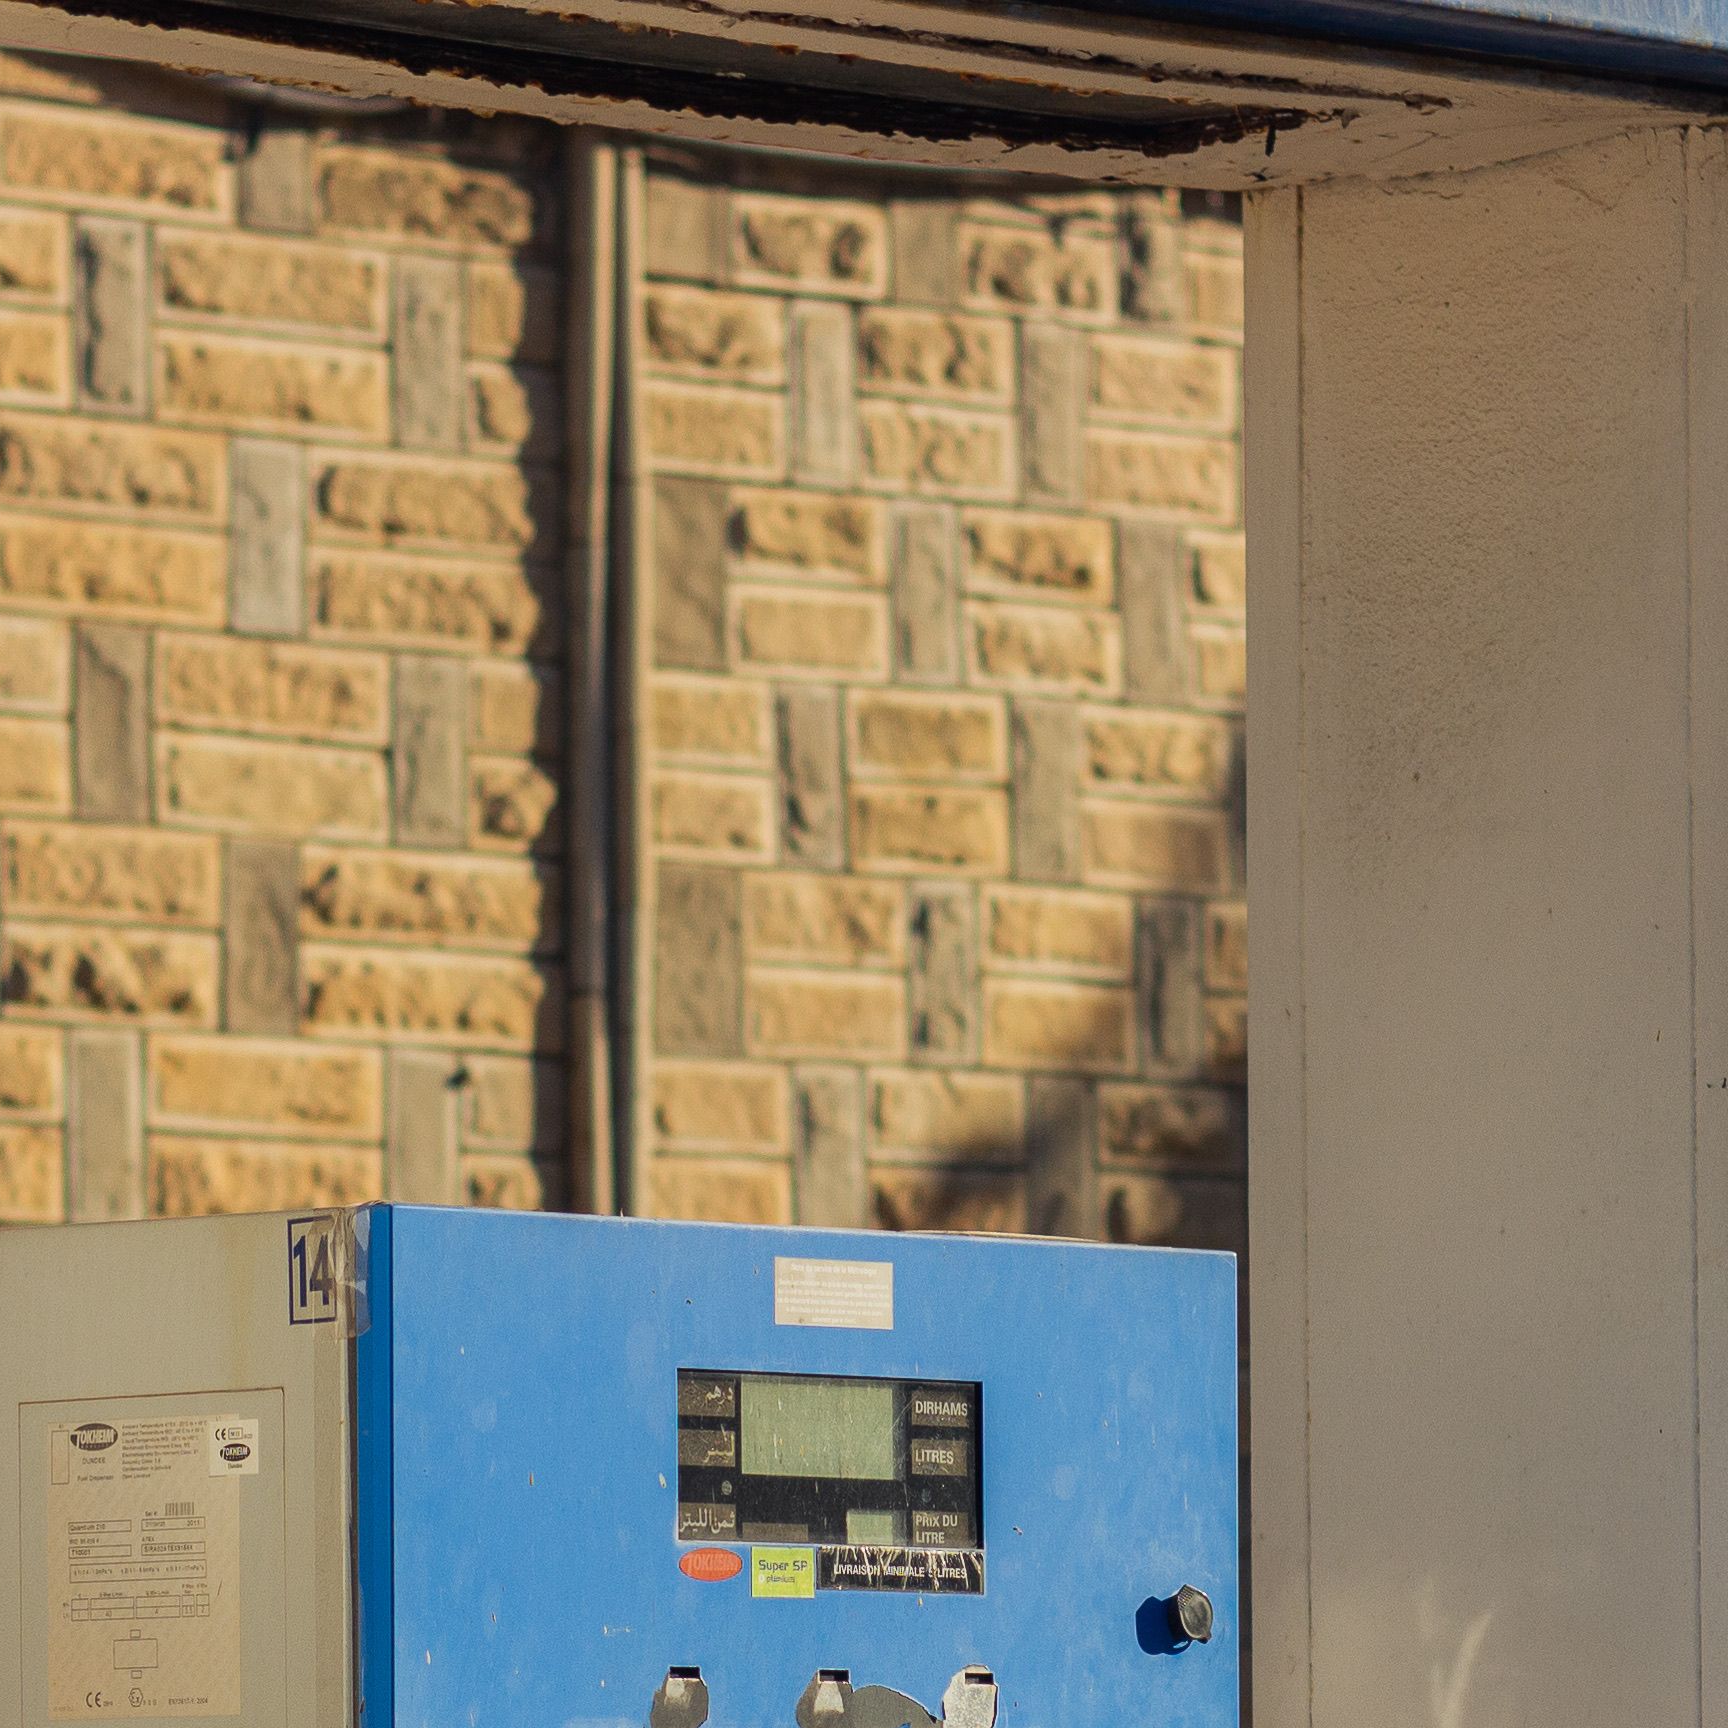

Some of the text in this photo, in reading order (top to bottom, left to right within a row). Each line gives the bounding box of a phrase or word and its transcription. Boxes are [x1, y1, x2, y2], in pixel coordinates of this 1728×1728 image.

[293, 1234, 335, 1307] 14
[915, 1400, 968, 1417] DIRHAMS
[915, 1449, 954, 1465] LITRES
[711, 1510, 735, 1534] ثمن
[915, 1514, 958, 1528] PRIX DU
[915, 1531, 945, 1544] LITRE
[758, 1559, 808, 1572] Super SP
[833, 1563, 881, 1576] LIVRAISON
[937, 1566, 967, 1579] LITRES
